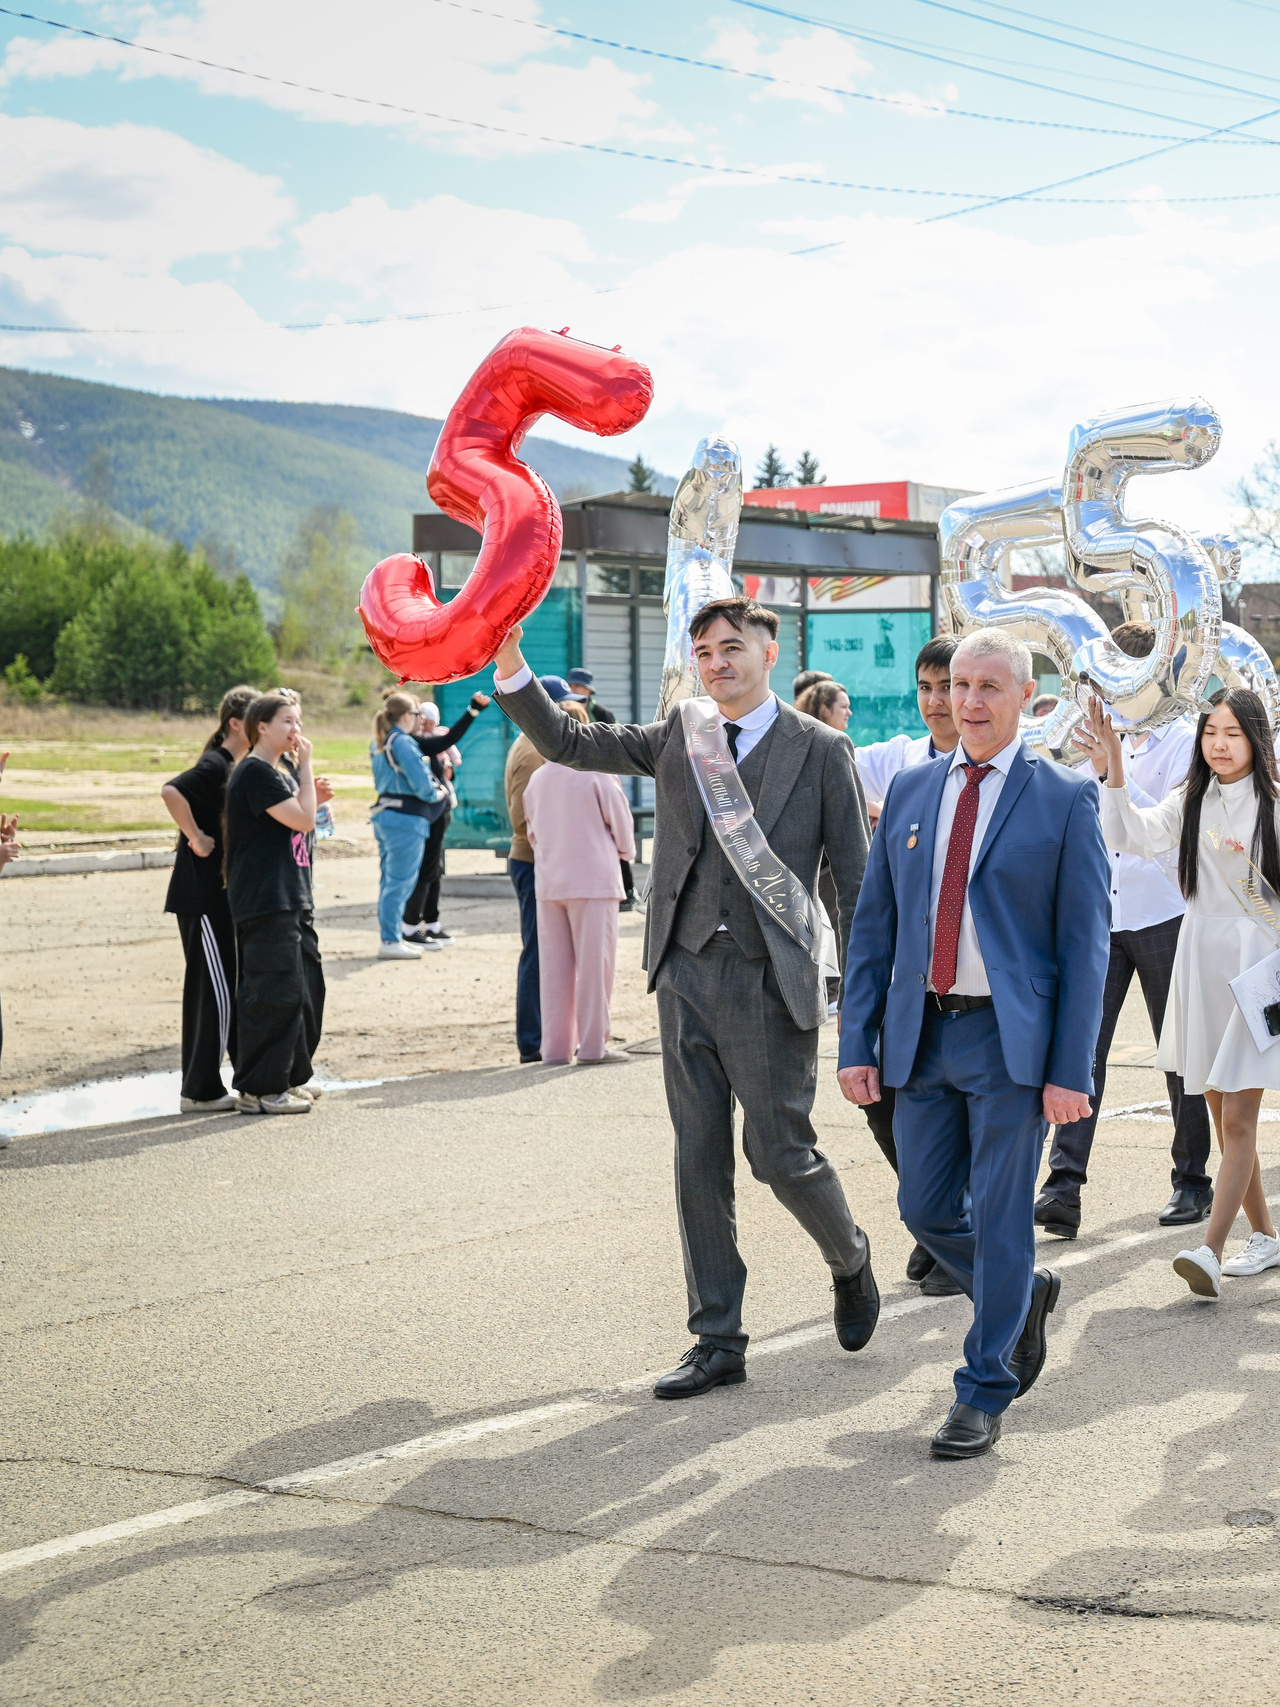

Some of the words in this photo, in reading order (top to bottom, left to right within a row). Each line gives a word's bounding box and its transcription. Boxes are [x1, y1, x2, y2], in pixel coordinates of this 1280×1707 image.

[358, 326, 654, 684] 5
[1060, 396, 1223, 736] 5
[752, 868, 803, 913] 2025
